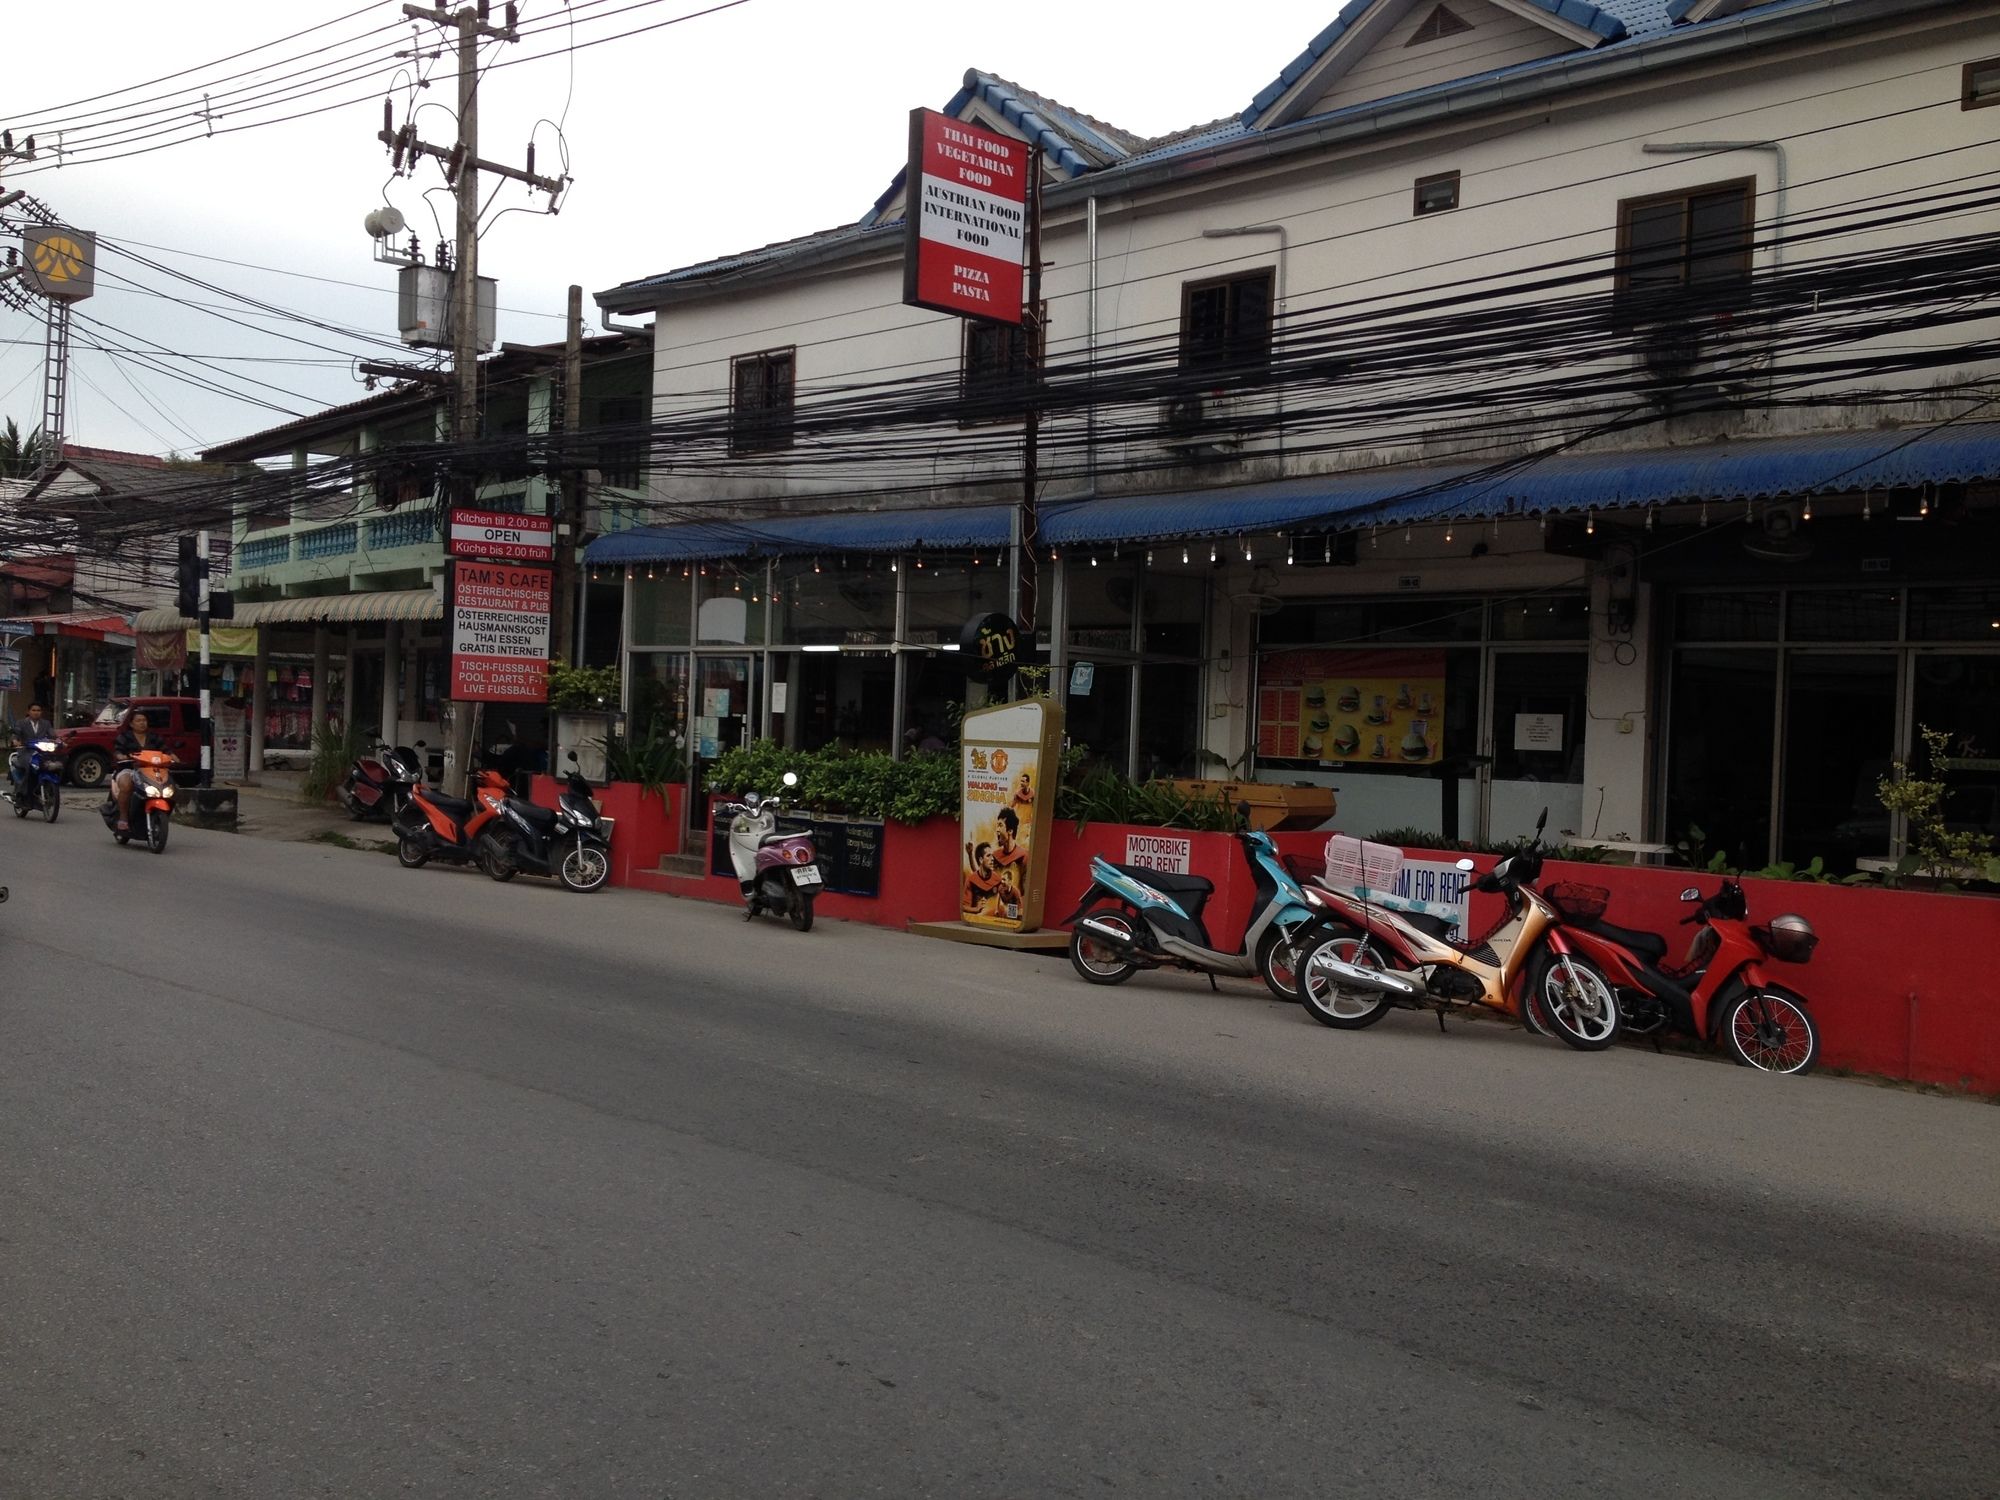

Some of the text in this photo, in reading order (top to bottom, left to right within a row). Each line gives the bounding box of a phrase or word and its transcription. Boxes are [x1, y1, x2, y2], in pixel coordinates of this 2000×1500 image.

[944, 126, 1009, 158] THAI FOOD
[936, 142, 1014, 177] VEGETARIAN
[959, 167, 992, 187] FOOD
[925, 184, 1021, 222] AUSTRIAN FOOD
[924, 202, 1021, 240] INTERNATIONAL
[957, 229, 989, 247] FOOD
[953, 264, 990, 284] PIZZA
[952, 282, 990, 301] PASTA
[456, 512, 492, 525] Kitchen
[495, 515, 505, 525] till
[508, 516, 528, 528] 2.00
[484, 529, 521, 542] OPEN
[456, 542, 487, 554] Küche
[489, 544, 503, 556] bis
[506, 546, 527, 557] 2.00
[459, 568, 549, 590] TAM'S CAFE
[458, 595, 549, 611] RESTAURANT & PUB
[457, 609, 548, 625] ÖSTERREICHISCHE
[458, 621, 546, 636] HAUSMANNSKOST
[474, 633, 531, 645] THAI ESSEN
[459, 642, 544, 656] GRATIS INTERNET
[460, 660, 542, 674] TISCH-FUSSBALL
[463, 683, 538, 696] LIVE FUSSBALL
[1129, 836, 1187, 856] MOTORBIKE
[1134, 854, 1182, 873] FOR RENT
[1415, 869, 1435, 902] FOR
[1440, 871, 1467, 905] RENT
